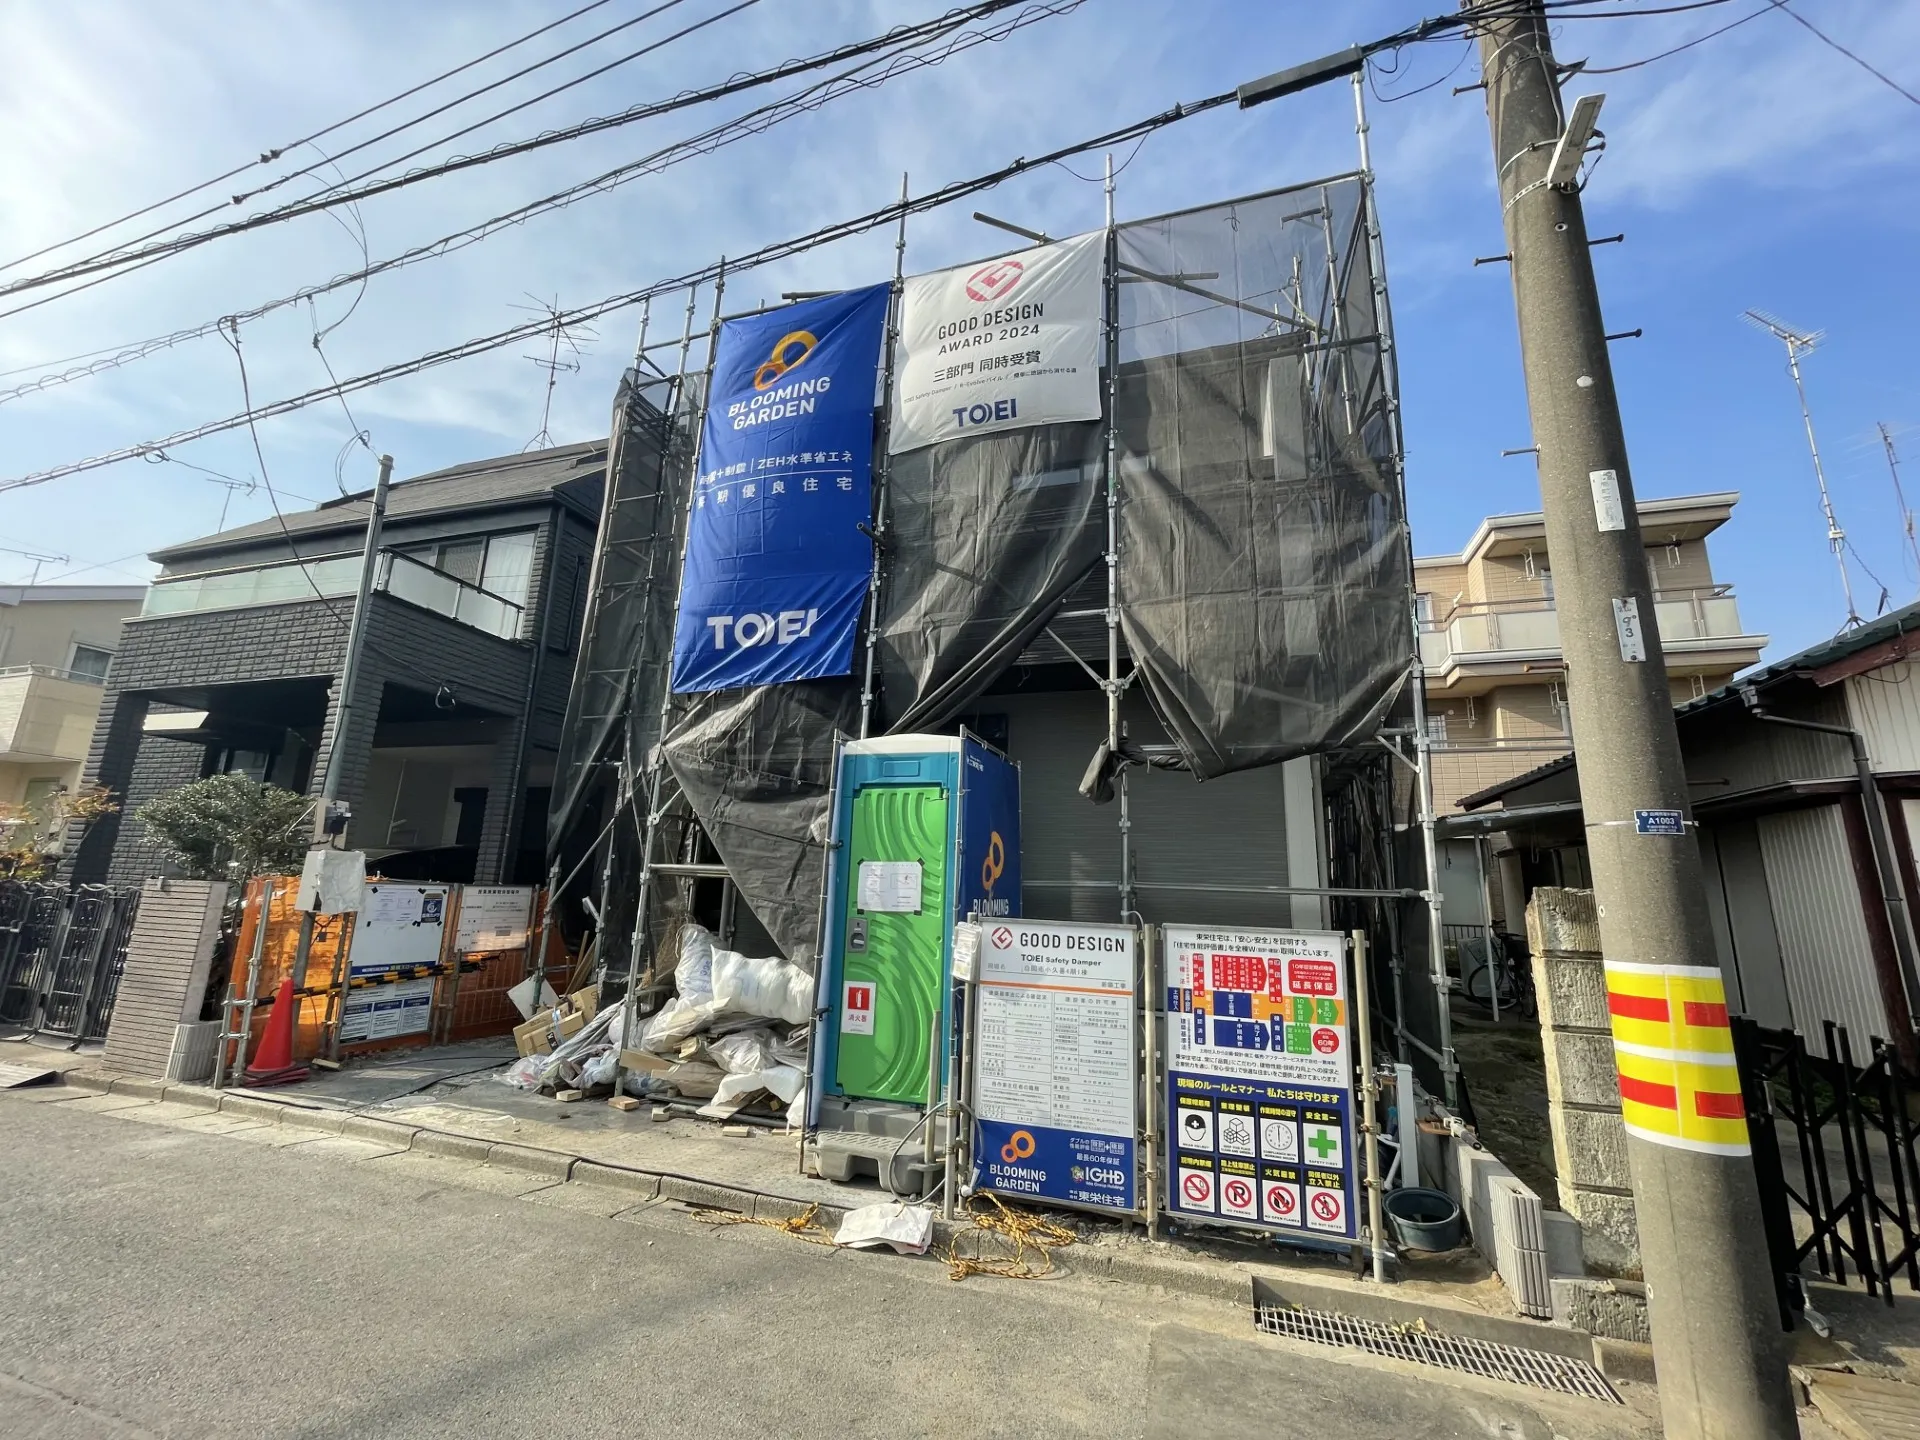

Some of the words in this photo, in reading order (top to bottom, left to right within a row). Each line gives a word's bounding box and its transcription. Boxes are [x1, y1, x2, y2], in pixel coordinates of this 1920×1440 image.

[938, 316, 978, 341] GOOD
[983, 303, 1044, 326] DESIGN
[938, 333, 993, 356] AWARD
[999, 324, 1040, 341] 2024
[933, 361, 974, 383] 三部門
[979, 350, 1041, 373] 同時受賞
[727, 376, 831, 418] BLOOMING
[915, 391, 931, 401] Safety
[931, 386, 953, 397] Damper
[733, 397, 815, 431] GARDEN
[952, 398, 1017, 428] TOEI
[706, 608, 818, 650] TOEI
[1648, 817, 1675, 825] A1003
[1020, 932, 1061, 949] GOOD
[1066, 935, 1126, 952] DESIGN
[1021, 953, 1044, 963] TOEI
[1045, 956, 1069, 966] Safety
[1071, 957, 1102, 967] Damper
[848, 1013, 867, 1023] 消火器
[1176, 1077, 1265, 1096] 現場のルールとマナー
[1266, 1088, 1340, 1104] 私たちは守ります
[1305, 1111, 1337, 1121] 安全第一
[1076, 1152, 1121, 1166] 最長60年保証
[989, 1163, 1047, 1182] BLOOMING
[995, 1178, 1040, 1192] GARDEN
[1308, 1179, 1341, 1189] 立入禁止
[1078, 1190, 1125, 1207] 東栄住宅
